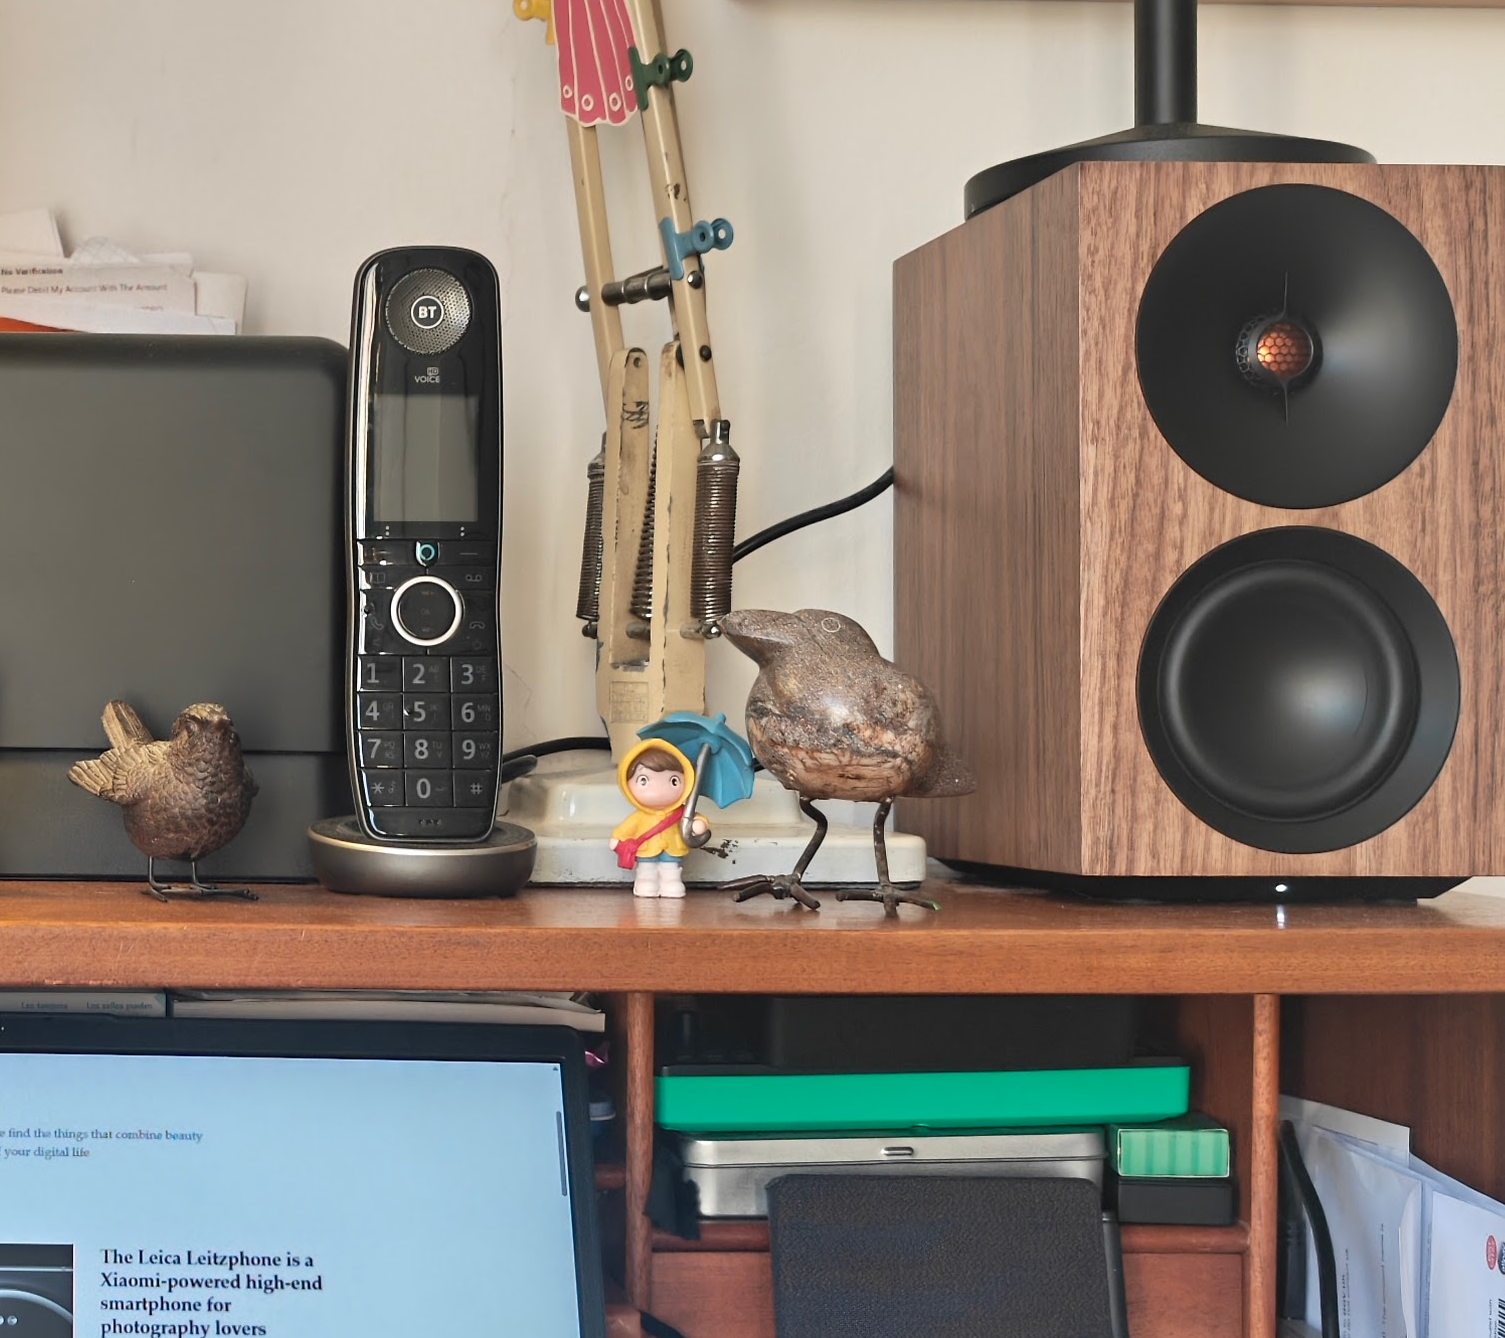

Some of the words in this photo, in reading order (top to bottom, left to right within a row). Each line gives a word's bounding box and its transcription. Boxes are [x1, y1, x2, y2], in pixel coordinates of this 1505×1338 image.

[418, 306, 437, 319] BT
[414, 375, 440, 383] VOICE
[367, 664, 379, 684] 1
[412, 664, 425, 684] 2
[461, 664, 474, 684] 3
[366, 701, 379, 720] 4
[413, 702, 426, 721] 5
[461, 702, 475, 722] 6
[367, 739, 381, 758] 7
[414, 739, 428, 759] 8
[462, 740, 475, 759] 9
[416, 778, 431, 798] 0
[9, 1128, 30, 1137] find
[34, 1128, 51, 1137] the
[54, 1129, 88, 1142] things
[91, 1130, 112, 1138] that
[116, 1130, 162, 1140] combine
[165, 1131, 202, 1142] beauty
[5, 1149, 31, 1159] your
[34, 1147, 69, 1159] digital
[72, 1147, 89, 1157] life
[99, 1249, 133, 1263] The
[139, 1250, 180, 1264] Leica
[188, 1251, 281, 1269] Leitzphone
[287, 1252, 300, 1266] is
[305, 1257, 313, 1267] a
[101, 1273, 240, 1293] Xiaomi-powered
[246, 1274, 322, 1294] high-end
[101, 1296, 201, 1315] smartphone
[207, 1297, 231, 1311] for
[102, 1319, 210, 1338] photography
[216, 1320, 266, 1335] lovers
